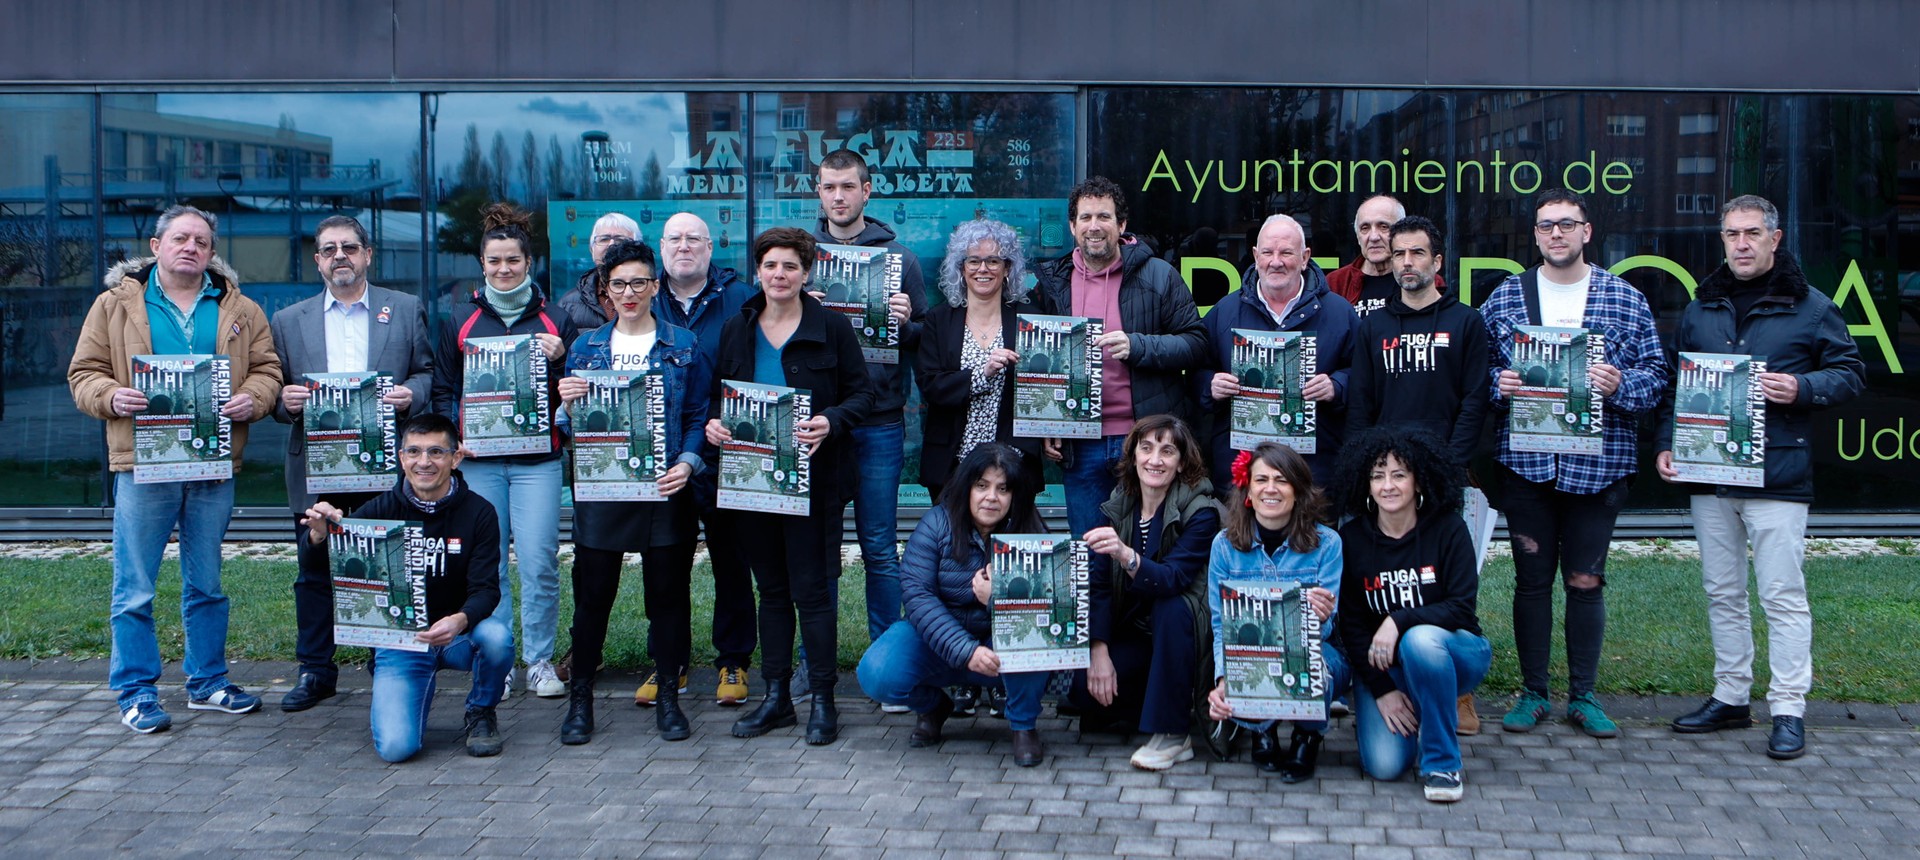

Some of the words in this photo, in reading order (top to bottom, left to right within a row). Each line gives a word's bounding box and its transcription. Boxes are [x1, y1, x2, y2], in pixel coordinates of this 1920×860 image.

[934, 132, 966, 147] 225
[1007, 138, 1031, 152] 586
[585, 141, 600, 154] 53
[604, 141, 632, 154] KM
[667, 130, 744, 170] LA
[770, 129, 921, 169] FUGA
[590, 156, 618, 168] 1400
[1008, 154, 1030, 166] 206
[1015, 168, 1022, 181] 3
[1142, 148, 1542, 203] Ayuntamiento
[1562, 150, 1633, 195] de
[775, 173, 974, 195] LARKETA
[817, 251, 832, 261] LA
[831, 249, 859, 260] FUGA
[885, 266, 891, 274] 17
[887, 297, 900, 346] RTXA
[1017, 321, 1034, 332] LA
[1032, 319, 1060, 330] FUGA
[1085, 336, 1091, 344] 17
[1091, 323, 1103, 364] MENDI
[1233, 336, 1248, 347] LA
[1246, 335, 1274, 345] FUGA
[1382, 337, 1399, 350] LA
[1515, 332, 1531, 343] LA
[1529, 331, 1558, 342] FUGA
[465, 346, 479, 355] LA
[478, 341, 505, 352] FUGA
[1299, 350, 1306, 358] 17
[1586, 348, 1592, 356] 17
[1592, 334, 1605, 364] MEN
[529, 352, 535, 360] 17
[612, 353, 649, 365] FUGA
[1305, 336, 1317, 378] MENDI
[134, 363, 151, 373] LA
[150, 360, 182, 370] FUGA
[1680, 360, 1695, 371] LA
[1693, 359, 1721, 369] FUGA
[212, 373, 218, 381] 17
[217, 359, 230, 402] MENDI
[319, 377, 350, 387] FUGA
[587, 375, 617, 385] FUGA
[1748, 375, 1754, 383] 17
[382, 375, 394, 415] MEDI
[645, 388, 652, 396] 17
[652, 374, 665, 419] MENDI
[723, 387, 739, 399] LA
[737, 387, 766, 400] FUGA
[1090, 367, 1103, 419] MARTXA
[536, 381, 550, 433] MARTXA
[792, 407, 799, 416] 17
[799, 394, 811, 434] MEND
[1304, 401, 1316, 433] RTXA
[1752, 409, 1767, 464] MARTXA
[384, 420, 396, 470] MARTXA
[653, 422, 667, 478] MARTXA
[329, 524, 344, 534] LA
[342, 523, 374, 535] FUGA
[403, 541, 410, 549] 17
[410, 526, 424, 571] MENDI
[423, 537, 446, 550] GA
[993, 543, 1009, 554] LA
[1008, 540, 1040, 551] FUGA
[1070, 555, 1076, 563] 17
[1076, 540, 1089, 587] MENDI
[1364, 575, 1382, 591] LA
[1379, 568, 1419, 586] FUGA
[1221, 589, 1238, 599] LA
[1237, 587, 1270, 598] FUGA
[412, 575, 428, 628] MARTXA
[1300, 603, 1308, 613] 17
[1076, 590, 1089, 645] MARTXA
[1307, 588, 1321, 635] NDI
[1308, 640, 1323, 697] MARTXA
